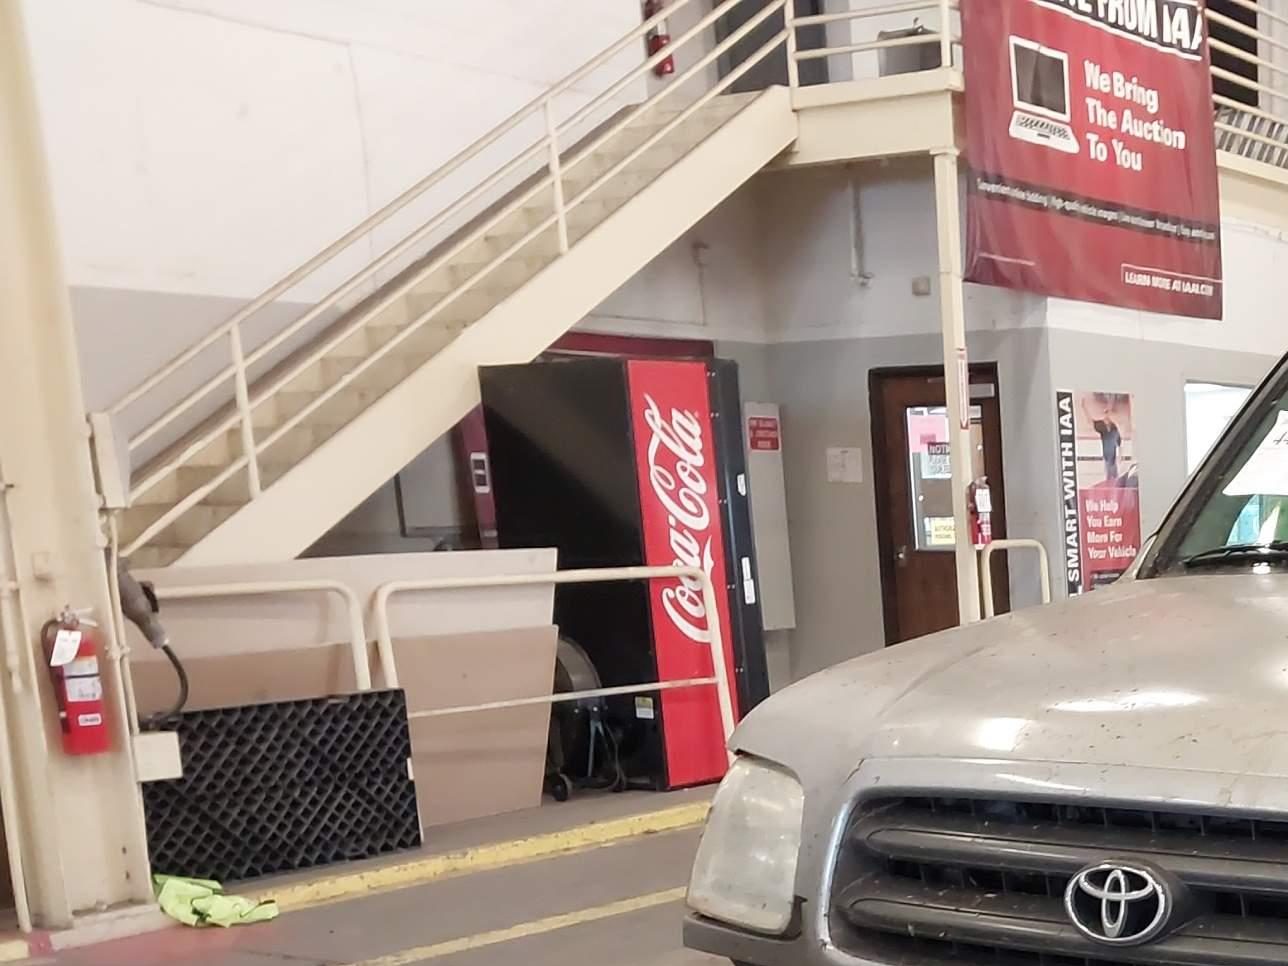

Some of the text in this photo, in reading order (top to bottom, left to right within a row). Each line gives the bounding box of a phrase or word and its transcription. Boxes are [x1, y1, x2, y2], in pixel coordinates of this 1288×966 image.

[1084, 60, 1158, 114] We Bring
[1085, 97, 1186, 150] The Auction
[1086, 132, 1142, 171] To You
[1059, 397, 1073, 435] IAA
[1061, 442, 1077, 500] WITH
[1086, 499, 1119, 514] We Help
[1087, 515, 1122, 528] You Earn
[1065, 509, 1080, 582] SMART
[1087, 531, 1123, 543] More For
[1088, 545, 1136, 559] Your Vehicle
